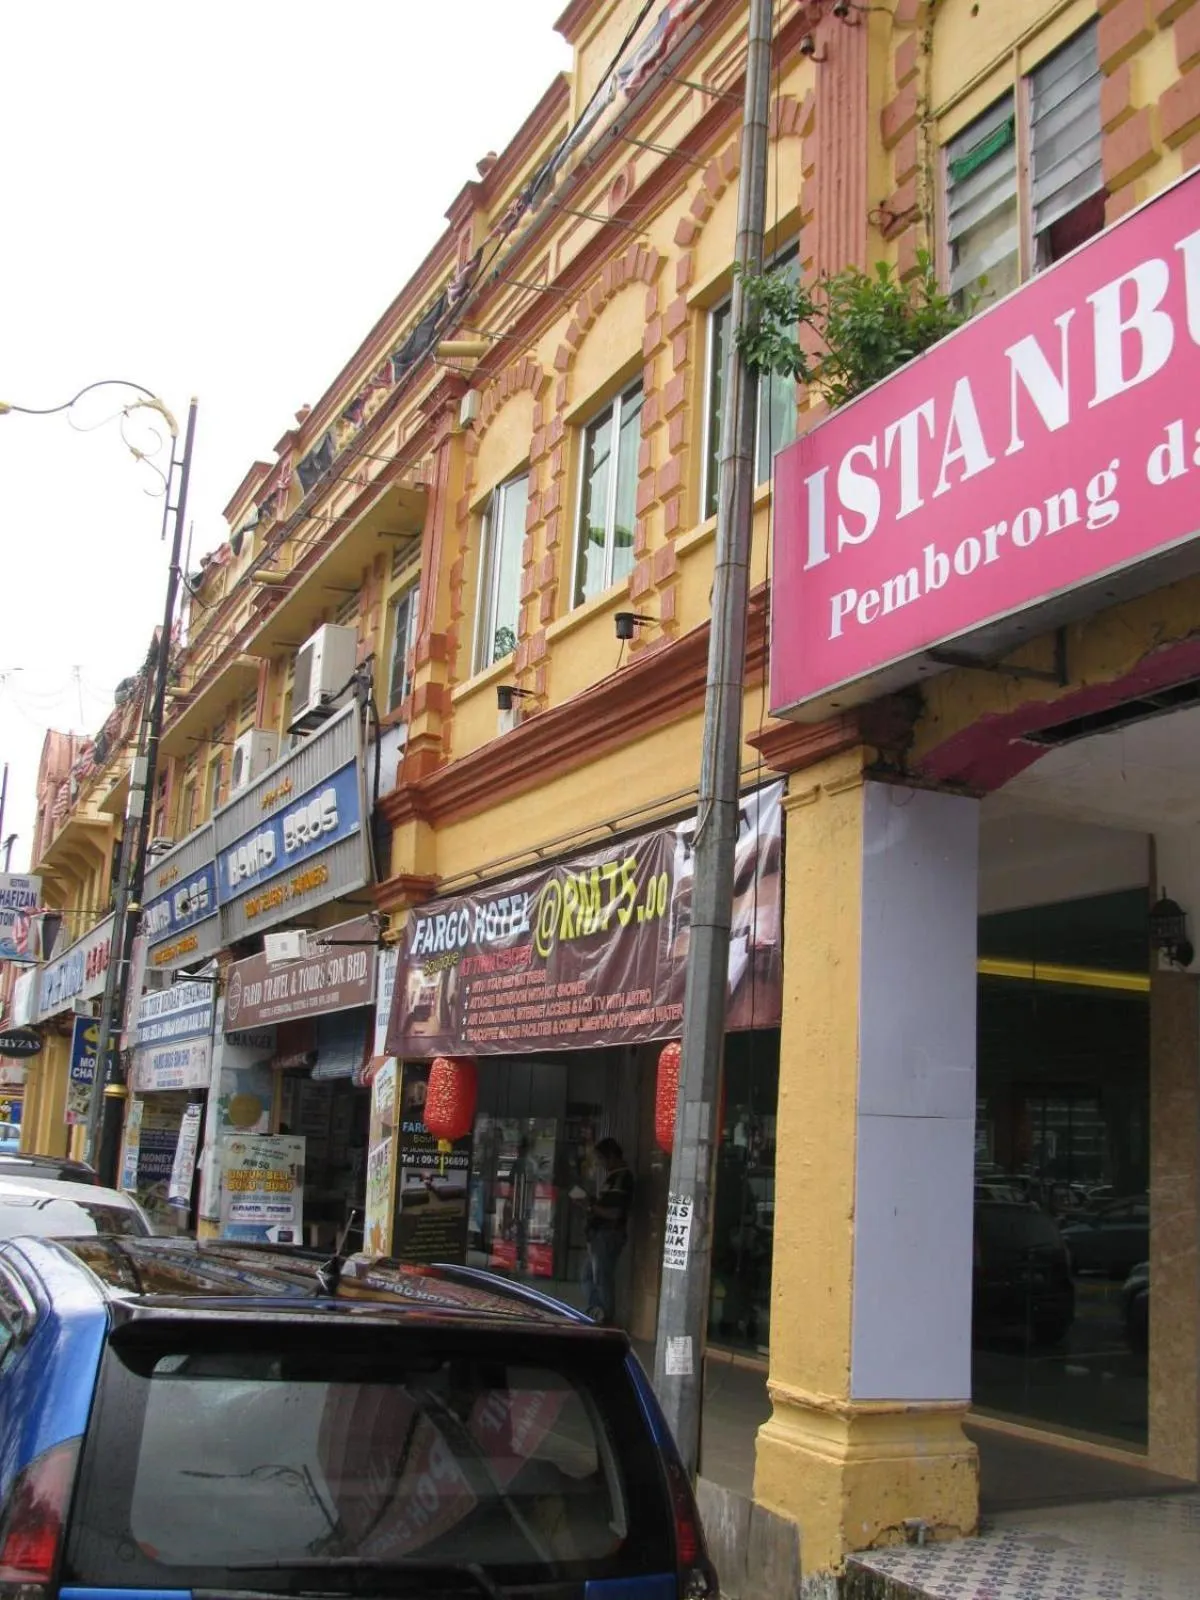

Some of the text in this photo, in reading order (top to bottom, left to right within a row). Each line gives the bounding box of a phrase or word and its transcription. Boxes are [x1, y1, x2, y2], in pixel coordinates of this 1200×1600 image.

[828, 458, 1120, 641] Pemborong
[283, 788, 339, 853] BROS
[410, 908, 470, 954] FARGO
[472, 892, 530, 943] HOTEL
[264, 974, 289, 1003] TRAVEL
[290, 971, 297, 996] &
[299, 965, 326, 994] TOURS
[557, 980, 588, 998] SHOWER
[547, 1000, 572, 1017] ACCESS
[593, 996, 606, 1011] TV
[607, 992, 625, 1009] WITH
[626, 988, 652, 1006] ASTRO
[656, 1003, 683, 1022] WATER
[142, 1153, 174, 1162] MONEY
[402, 1153, 415, 1163] Tel
[228, 1169, 289, 1181] UNTUK BELI
